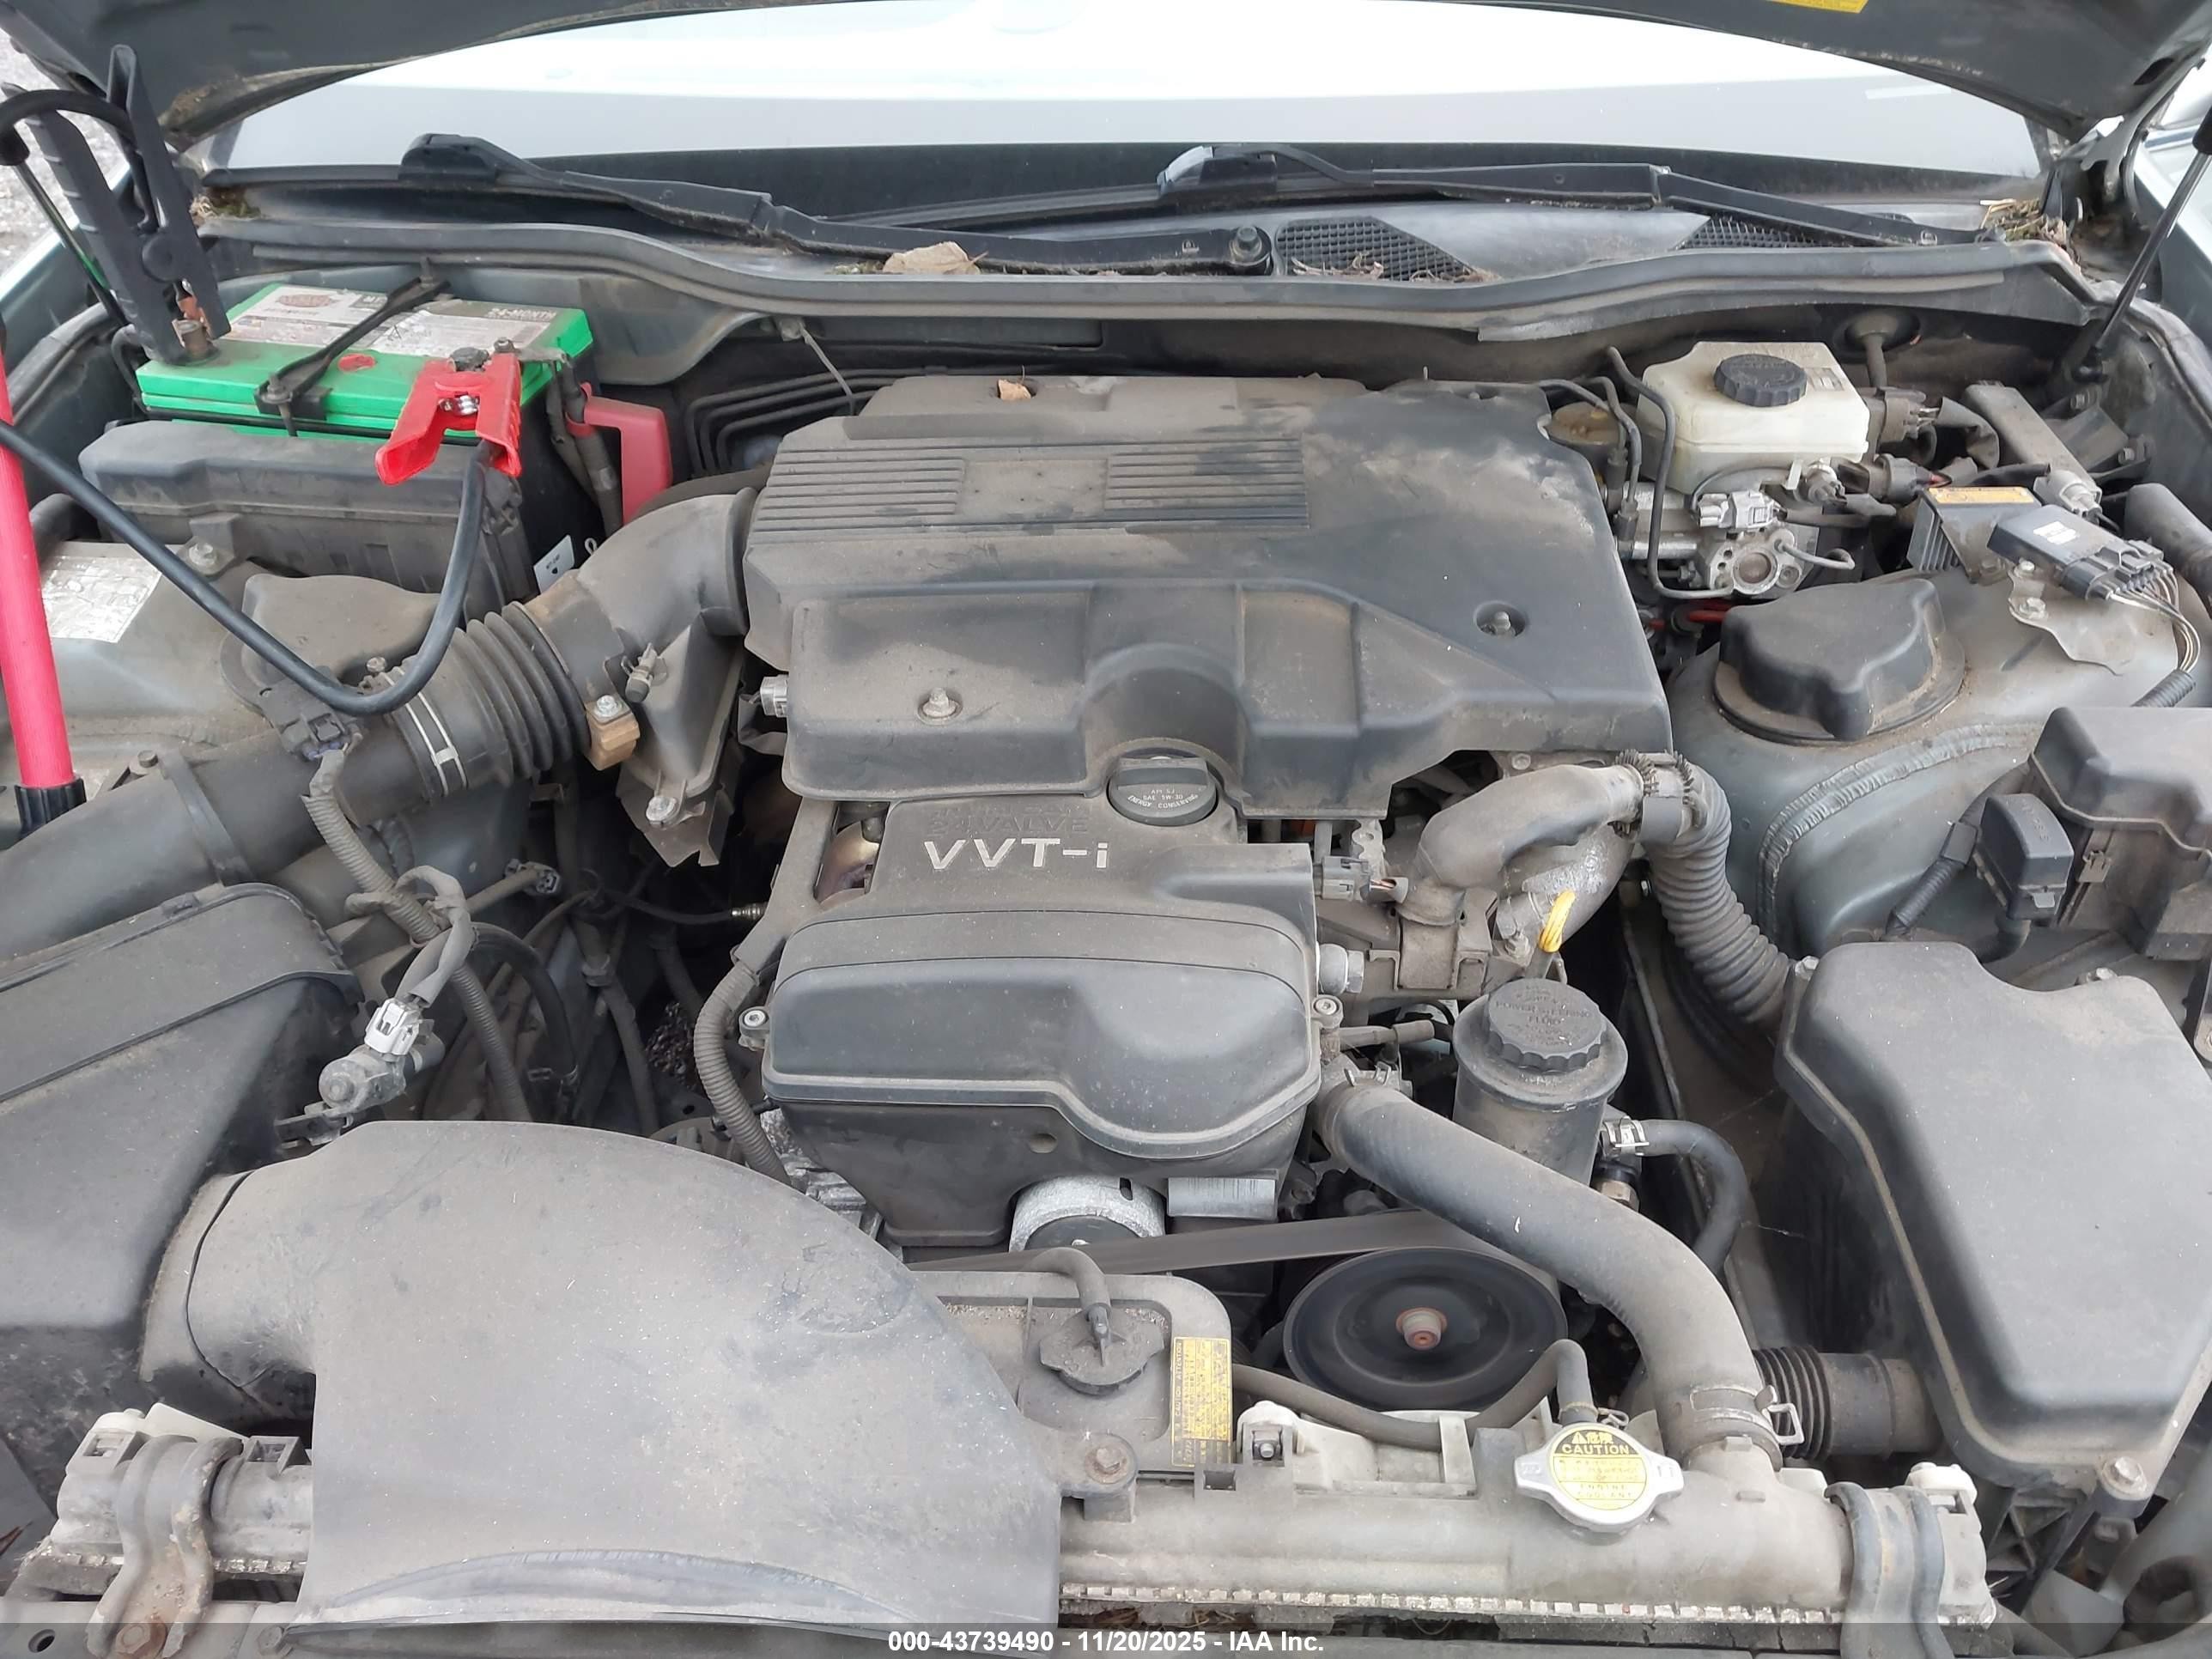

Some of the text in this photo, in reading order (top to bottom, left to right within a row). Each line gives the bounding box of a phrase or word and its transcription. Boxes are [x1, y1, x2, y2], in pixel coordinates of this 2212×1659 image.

[1127, 794, 1152, 807] ENERGY
[924, 837, 1109, 870] VVT-i
[1561, 1443, 1630, 1455] CAUTION
